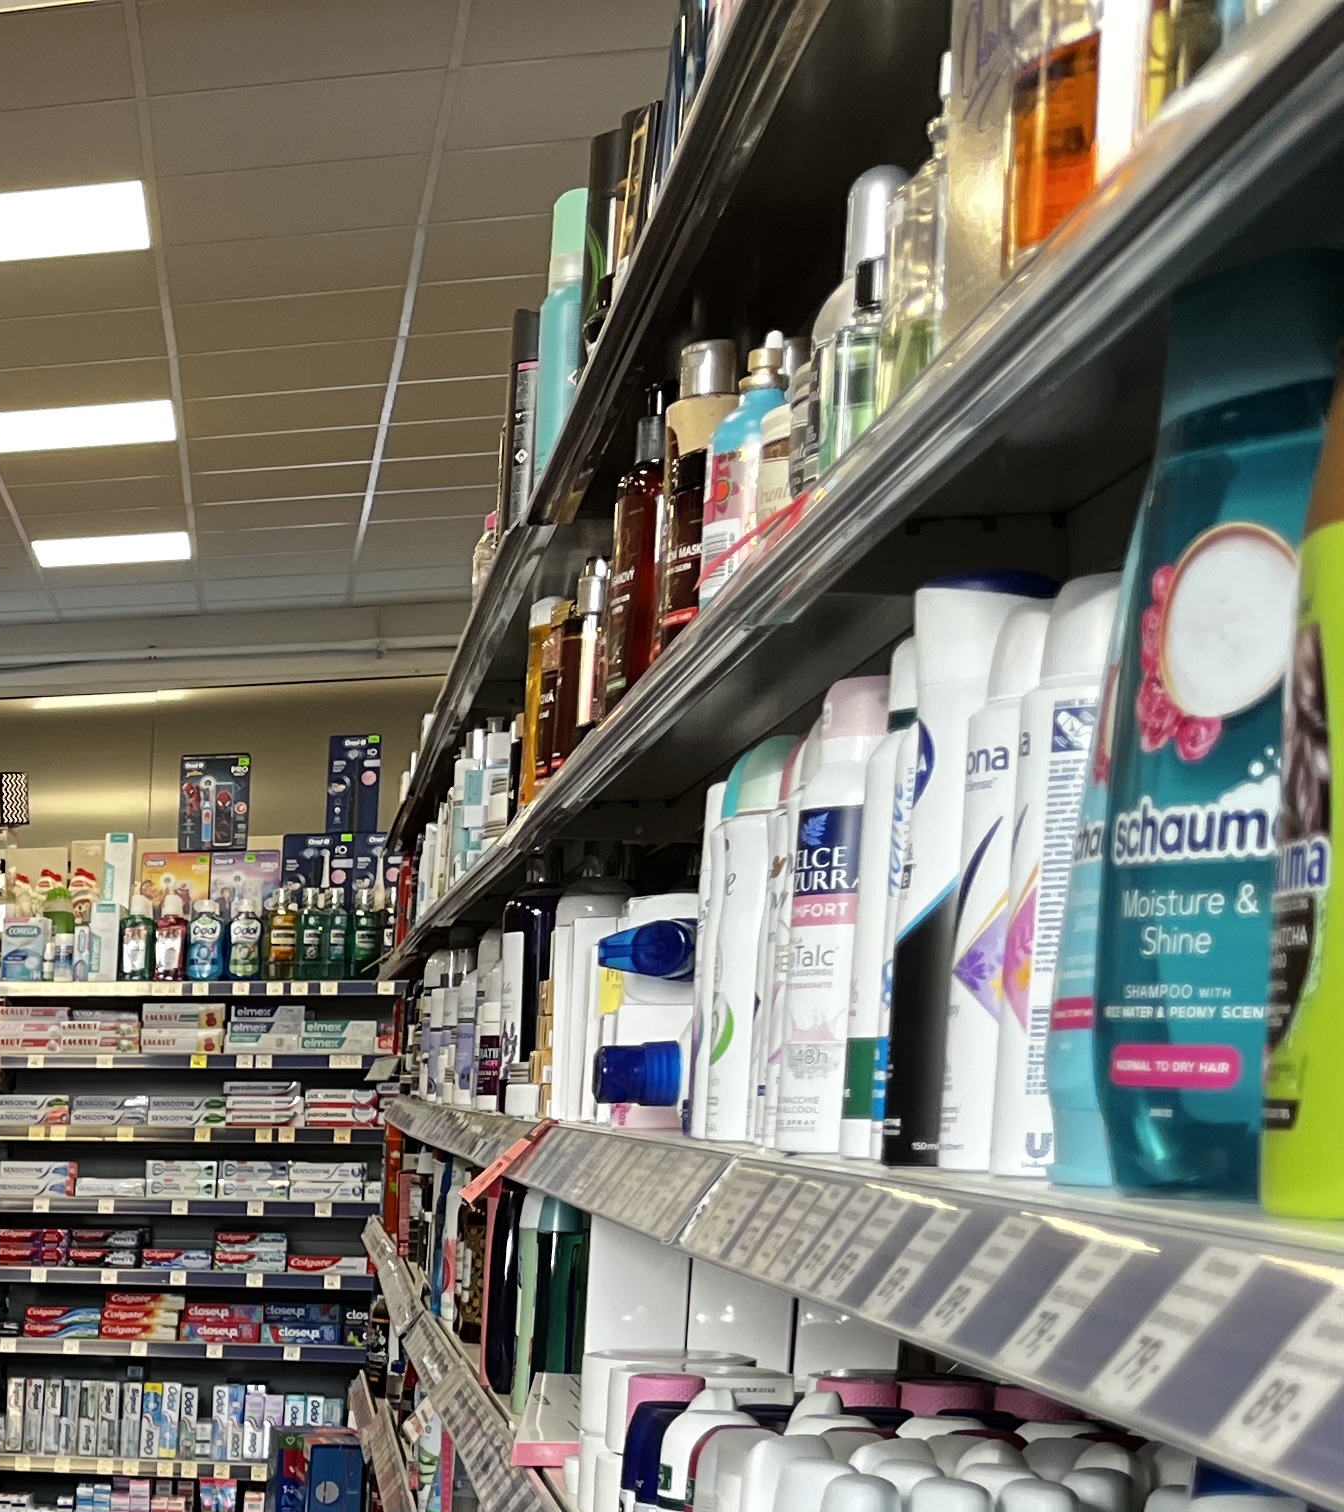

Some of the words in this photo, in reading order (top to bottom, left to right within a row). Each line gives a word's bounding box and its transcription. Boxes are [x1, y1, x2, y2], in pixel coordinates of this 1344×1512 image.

[1115, 800, 1278, 866] schaum
[1121, 888, 1226, 919] Moisture
[1236, 883, 1260, 915] &
[1141, 926, 1213, 957] Shine
[1124, 984, 1193, 999] SHAMPOO
[236, 1006, 272, 1018] elmex
[1169, 1006, 1216, 1019] PEONY
[1221, 1006, 1264, 1020] SCEN
[232, 1022, 268, 1033] elmex
[306, 1021, 343, 1033] elmex
[303, 1037, 339, 1049] elmex
[1172, 1061, 1196, 1073] DRY
[1199, 1062, 1230, 1074] HAIR
[152, 1099, 196, 1108] SENSODYNE
[73, 1113, 116, 1121] SENSODYNE
[150, 1114, 194, 1122] SENSODYNE
[3, 1166, 44, 1175] SENSODYNE
[292, 1167, 331, 1175] SENSODYNE
[292, 1187, 331, 1195] SENSODYNE
[0, 1229, 33, 1240] Colgate
[216, 1232, 251, 1243] Colgate
[69, 1248, 104, 1259] Colgate
[142, 1249, 177, 1260] Colgate
[215, 1251, 249, 1262] Colgate
[289, 1257, 333, 1270] Colgate
[111, 1293, 152, 1304] Colgate
[27, 1307, 63, 1319] Colgate
[103, 1309, 145, 1321] Colgate
[188, 1304, 230, 1319] closeup
[264, 1304, 306, 1319] closeup
[24, 1322, 60, 1334] Colgate
[101, 1324, 143, 1336] Colgate
[197, 1324, 239, 1340] closeup
[277, 1325, 321, 1340] closeup
[184, 1390, 195, 1417] Odol
